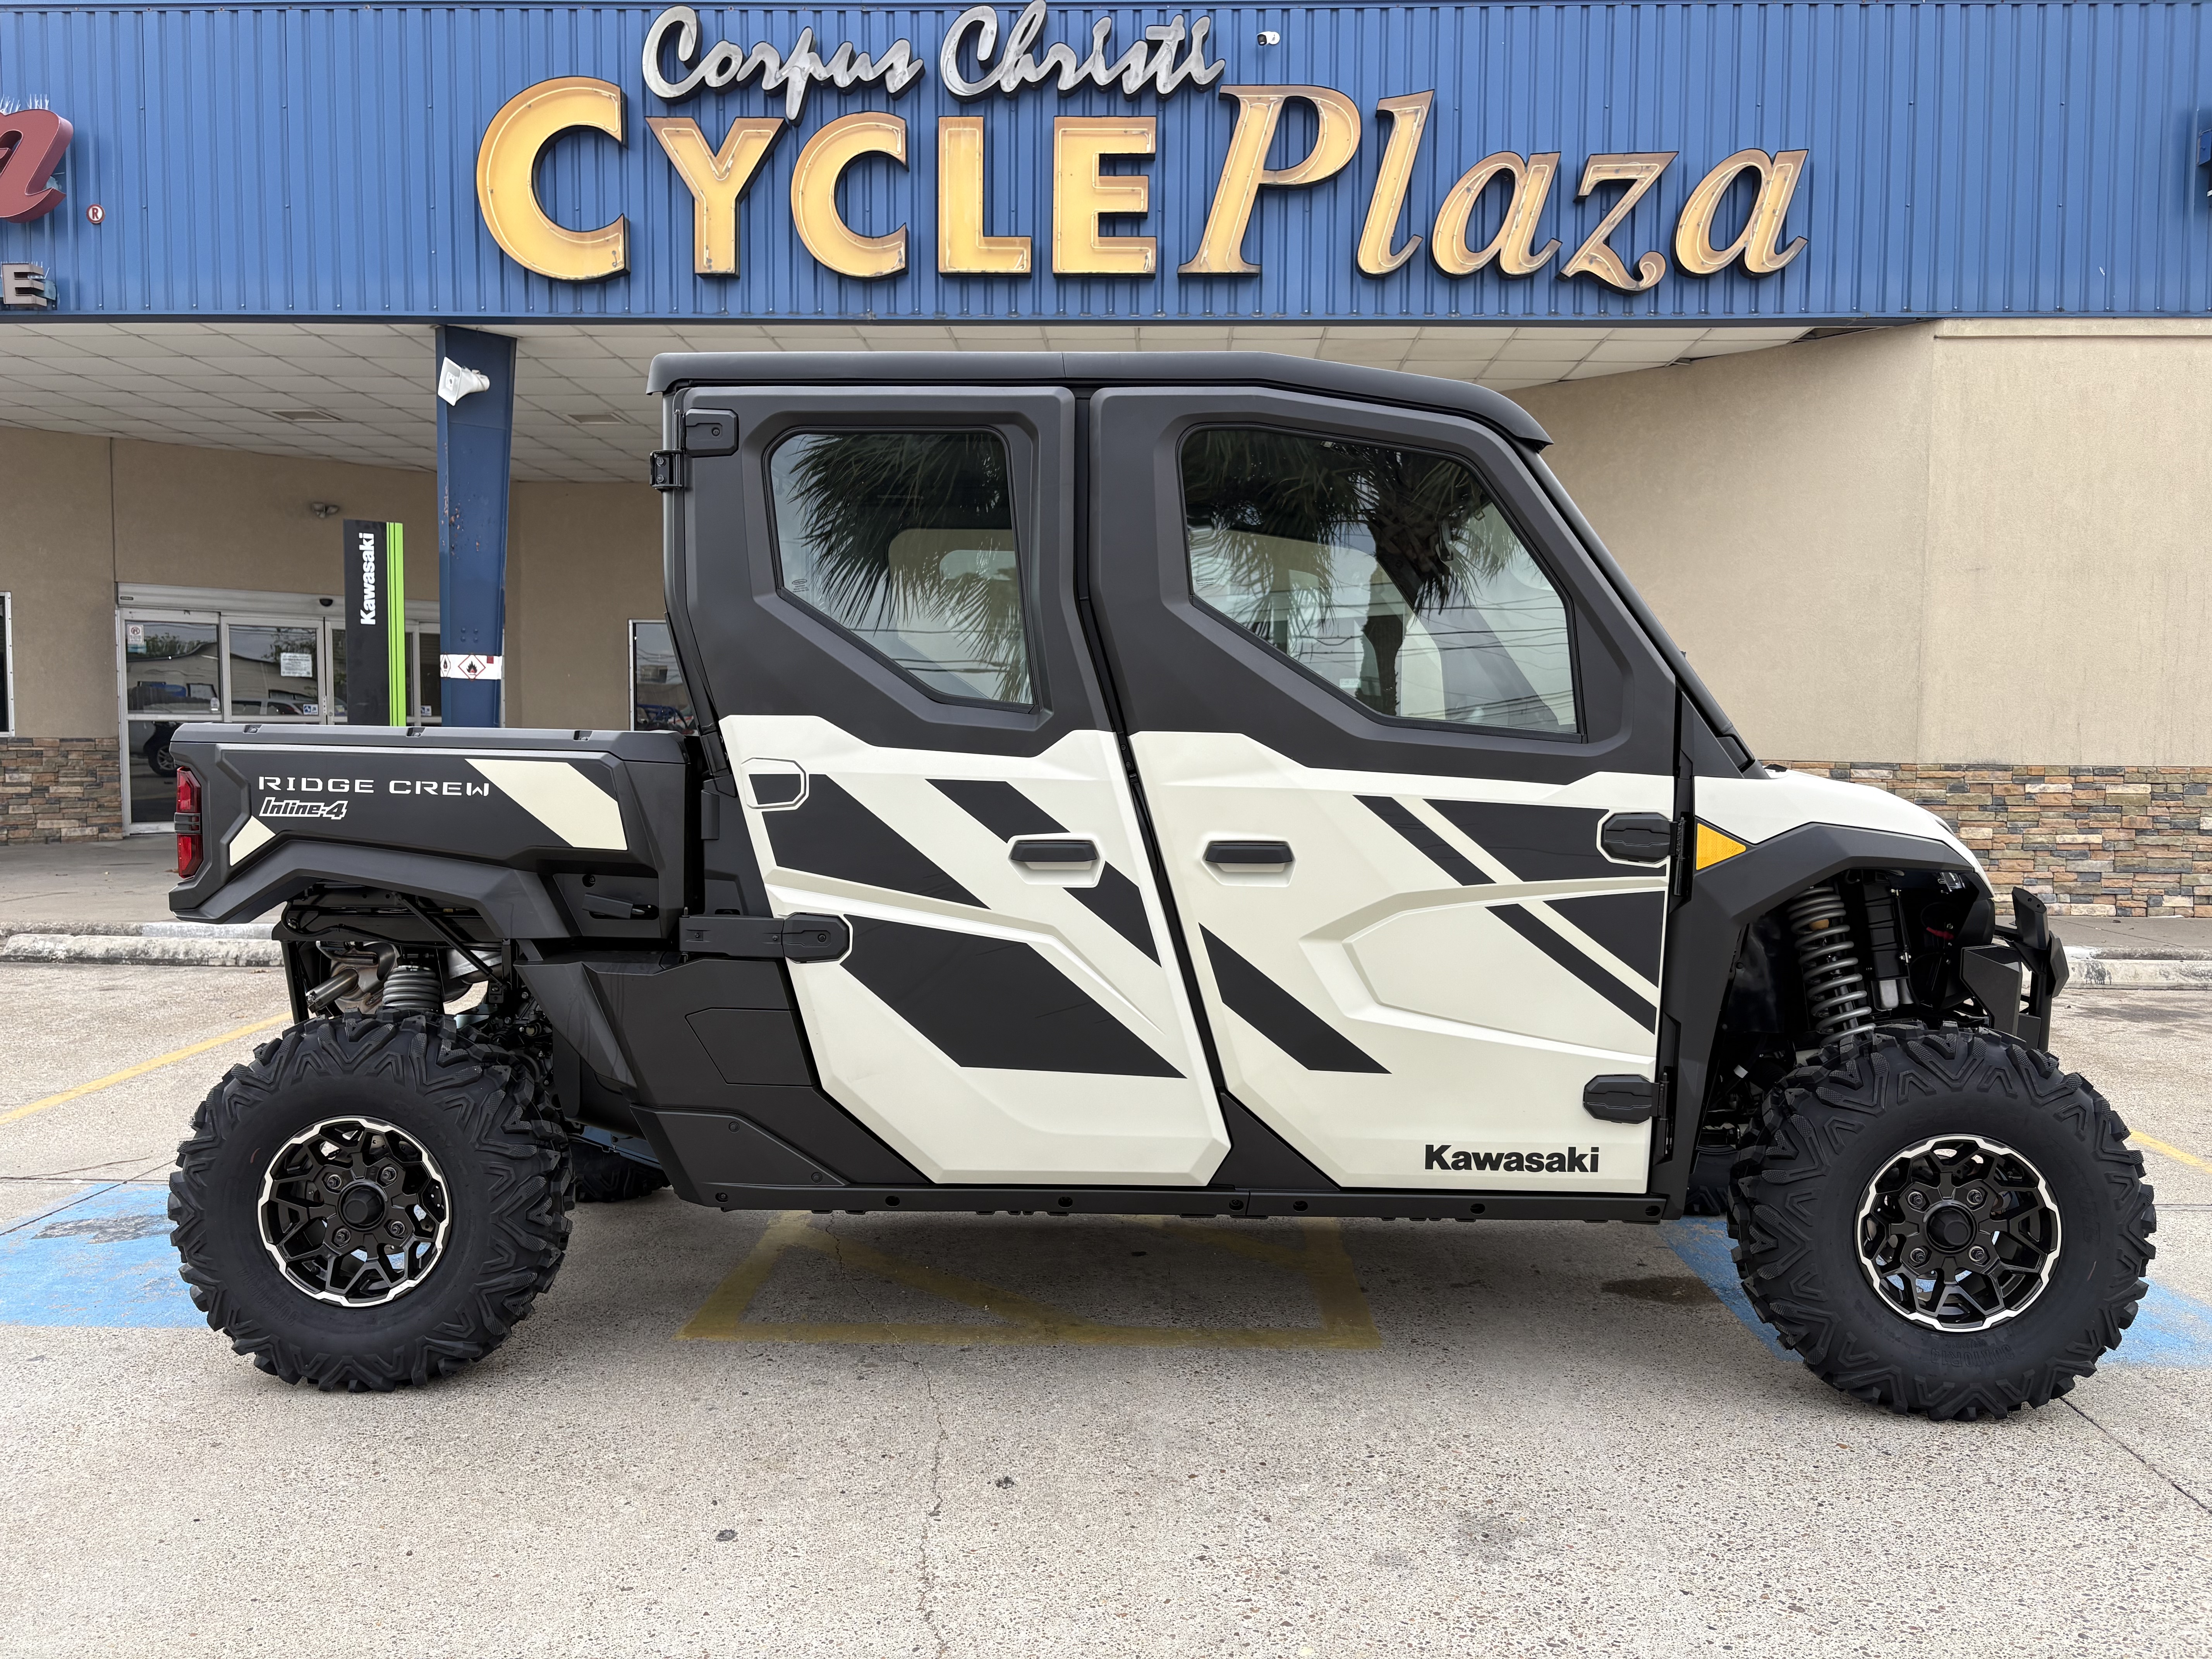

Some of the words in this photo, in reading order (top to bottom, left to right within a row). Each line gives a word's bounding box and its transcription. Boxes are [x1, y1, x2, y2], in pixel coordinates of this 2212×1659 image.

[642, 5, 926, 126] Corpus
[940, 0, 1226, 103] Christi
[477, 75, 1157, 283] CYCLE
[1177, 84, 1809, 296] Plaza
[359, 532, 376, 625] Kawasaki
[259, 776, 374, 793] RIDGE
[389, 780, 489, 797] CREW
[259, 797, 349, 820] Inline-4
[1425, 1144, 1599, 1173] Kawasaki
